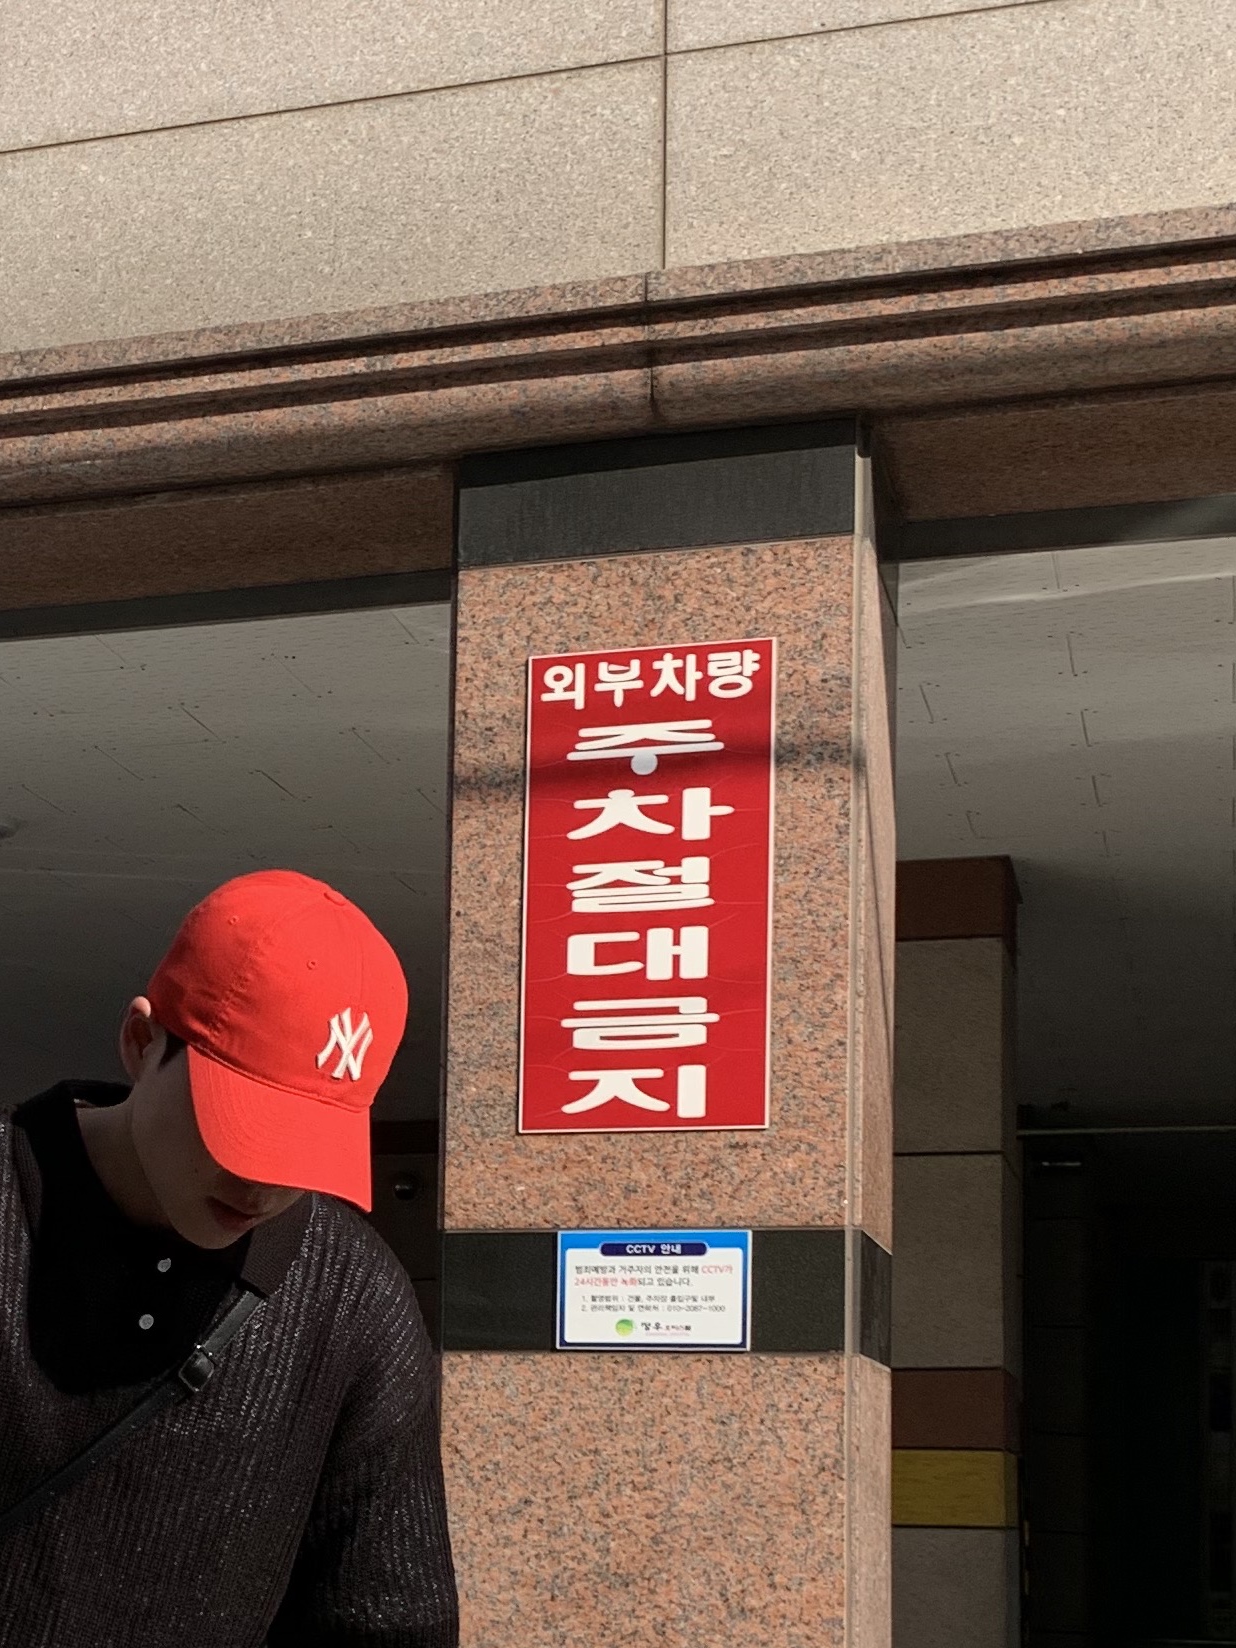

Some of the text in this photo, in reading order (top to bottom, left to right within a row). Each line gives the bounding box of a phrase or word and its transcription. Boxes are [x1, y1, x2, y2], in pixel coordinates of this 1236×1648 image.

[540, 649, 761, 710] 외부차량
[315, 1006, 374, 1081] NY
[625, 1243, 682, 1255] CCTV 안내
